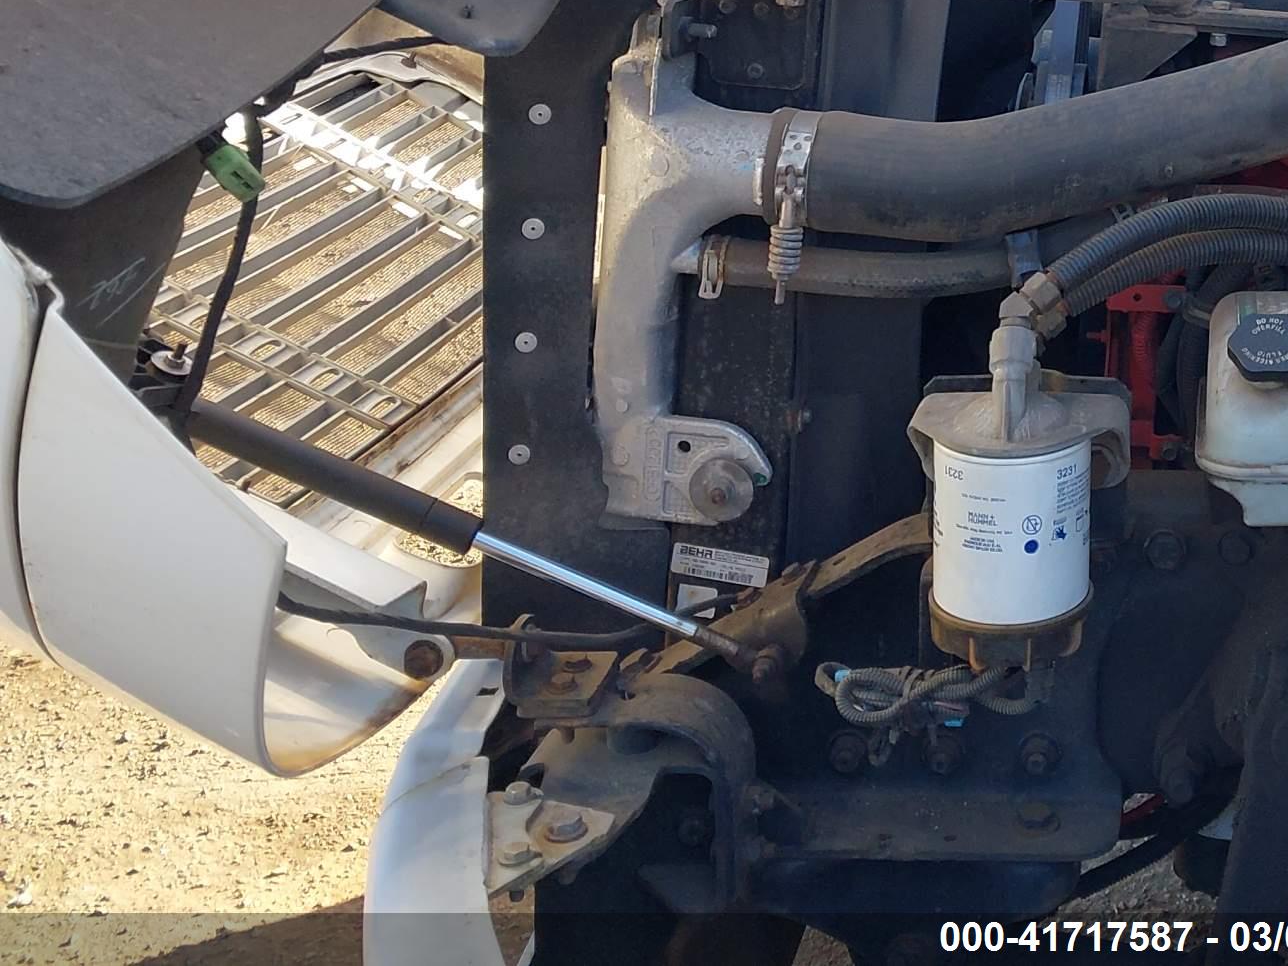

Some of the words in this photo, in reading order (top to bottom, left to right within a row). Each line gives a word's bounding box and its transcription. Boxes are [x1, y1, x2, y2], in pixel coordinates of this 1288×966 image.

[1269, 317, 1284, 325] NOT
[1251, 324, 1286, 335] OVERFILL
[944, 465, 964, 480] 3231
[1056, 464, 1078, 480] 3231
[680, 545, 713, 559] BEHR
